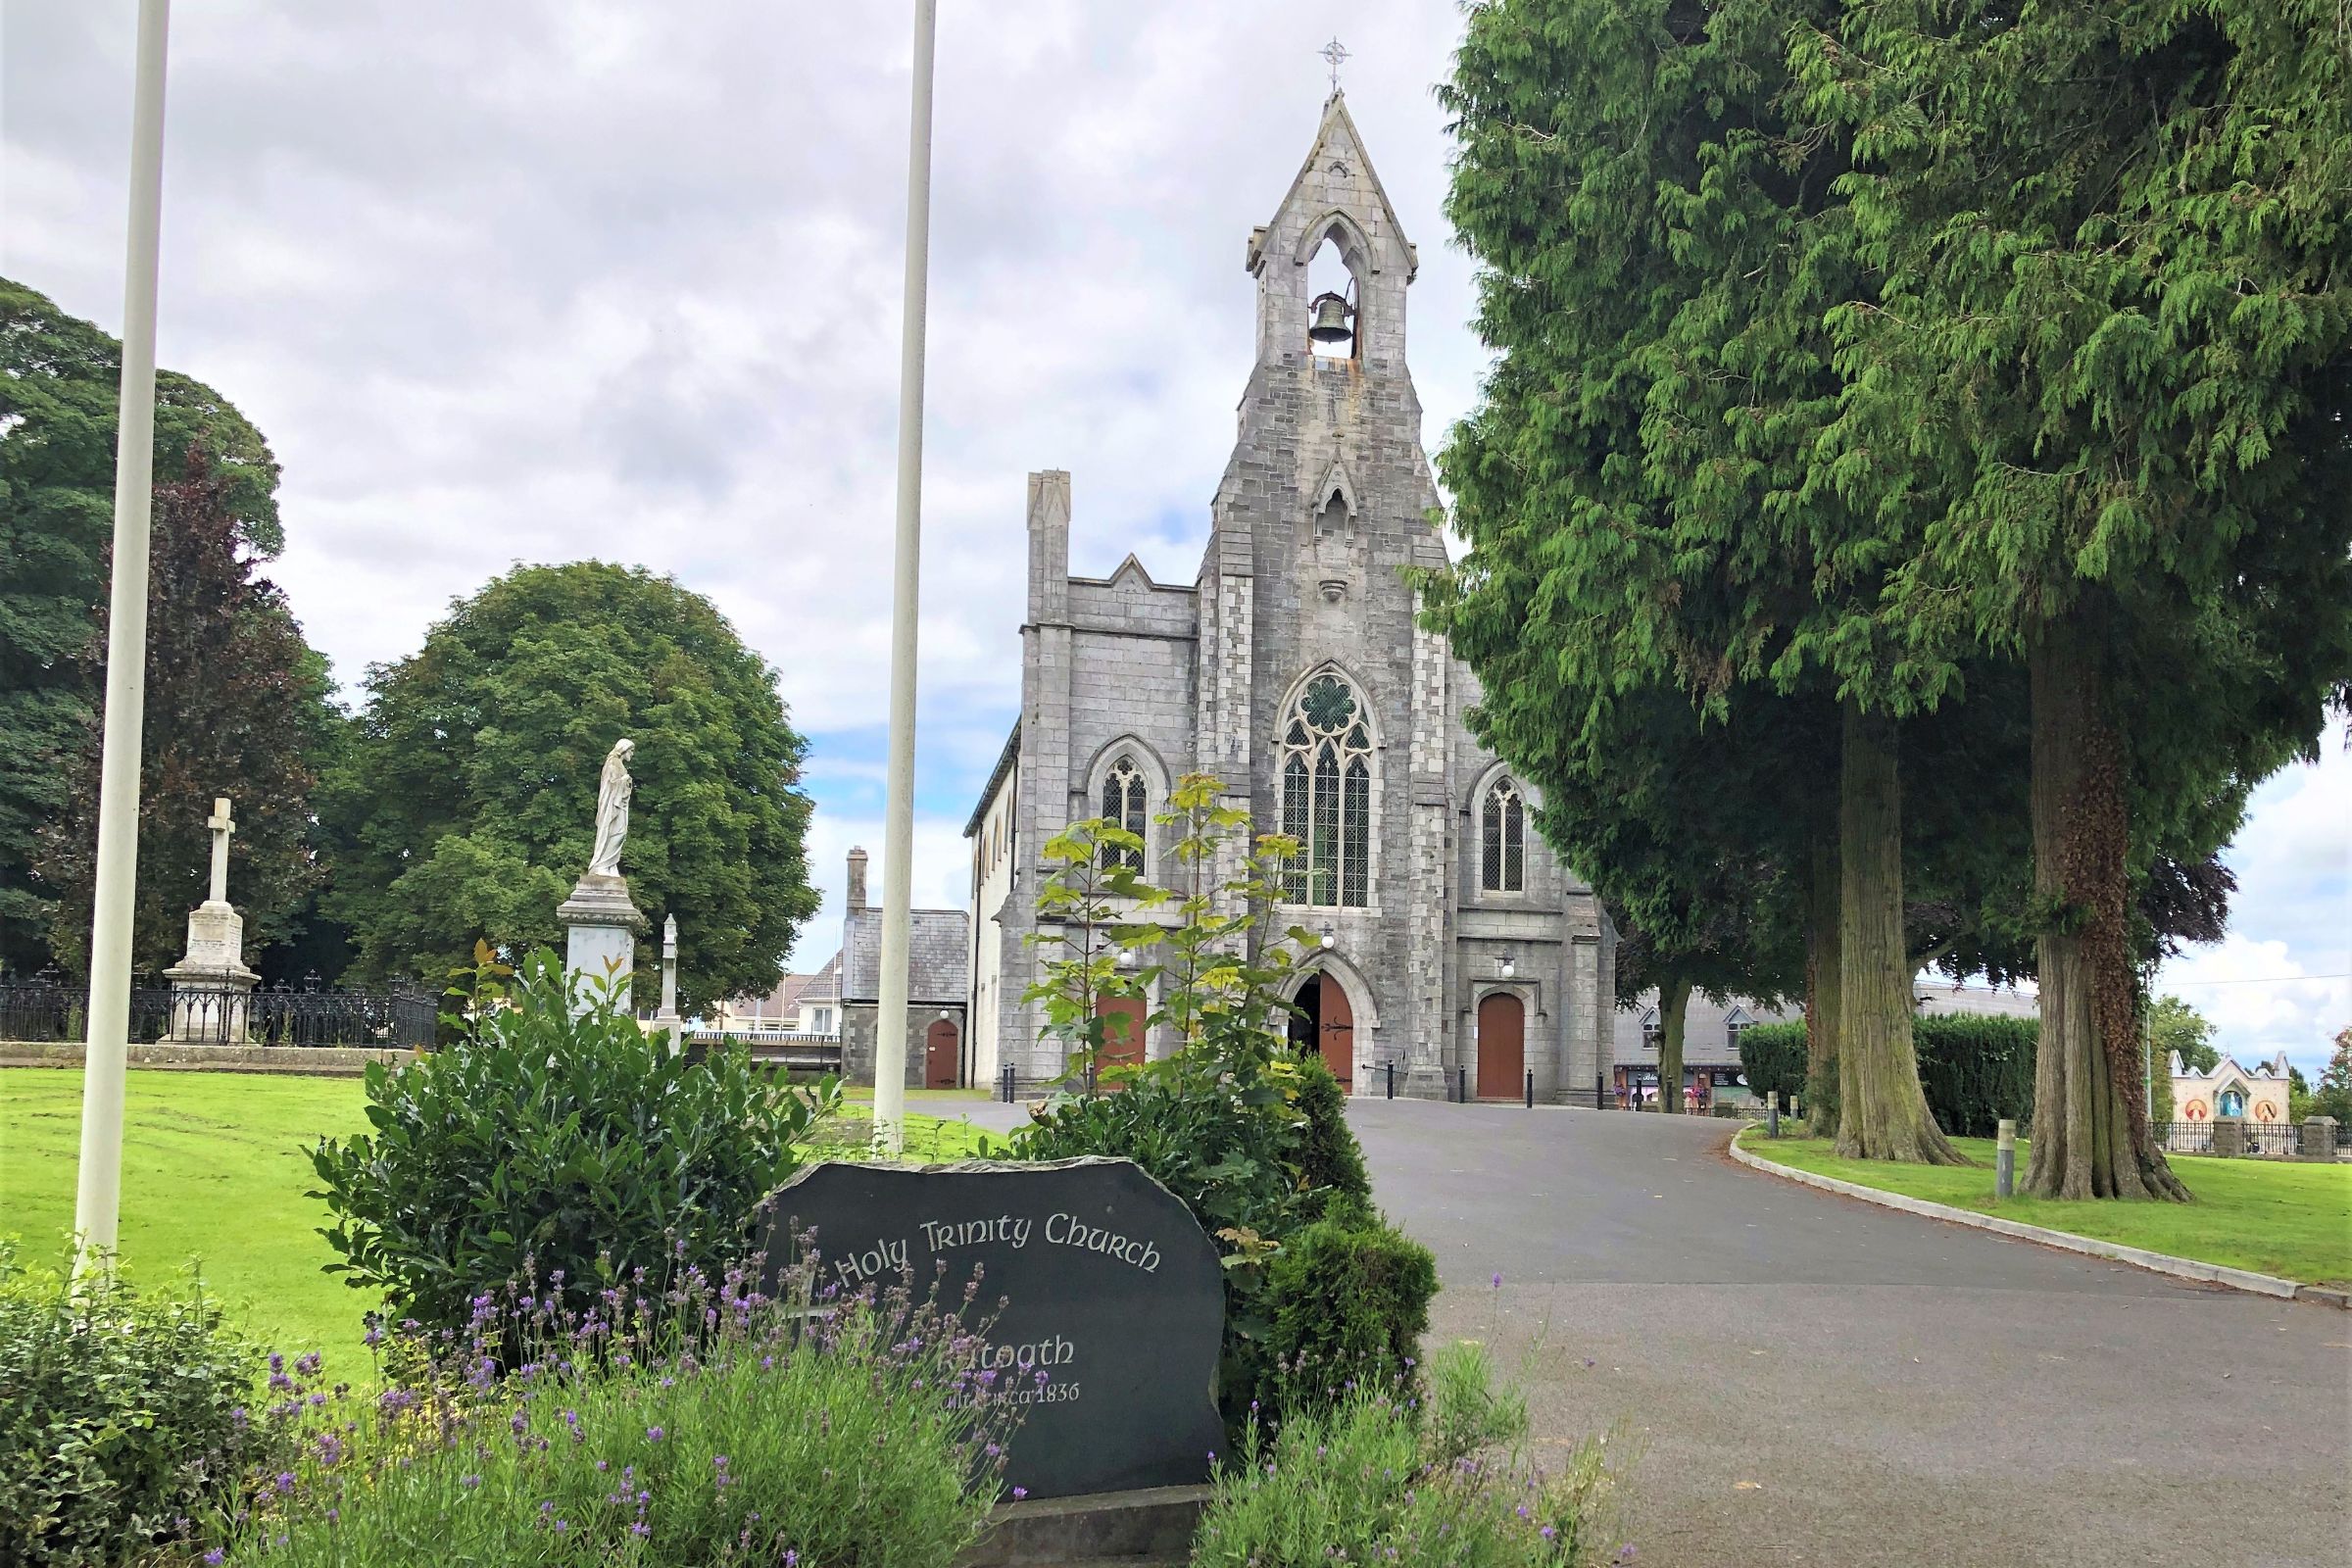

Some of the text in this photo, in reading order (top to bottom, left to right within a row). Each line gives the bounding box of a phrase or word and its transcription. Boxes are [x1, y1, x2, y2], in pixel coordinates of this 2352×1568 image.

[834, 1212, 1161, 1289] Holy Trinity Church
[1035, 1382, 1080, 1403] 1836
